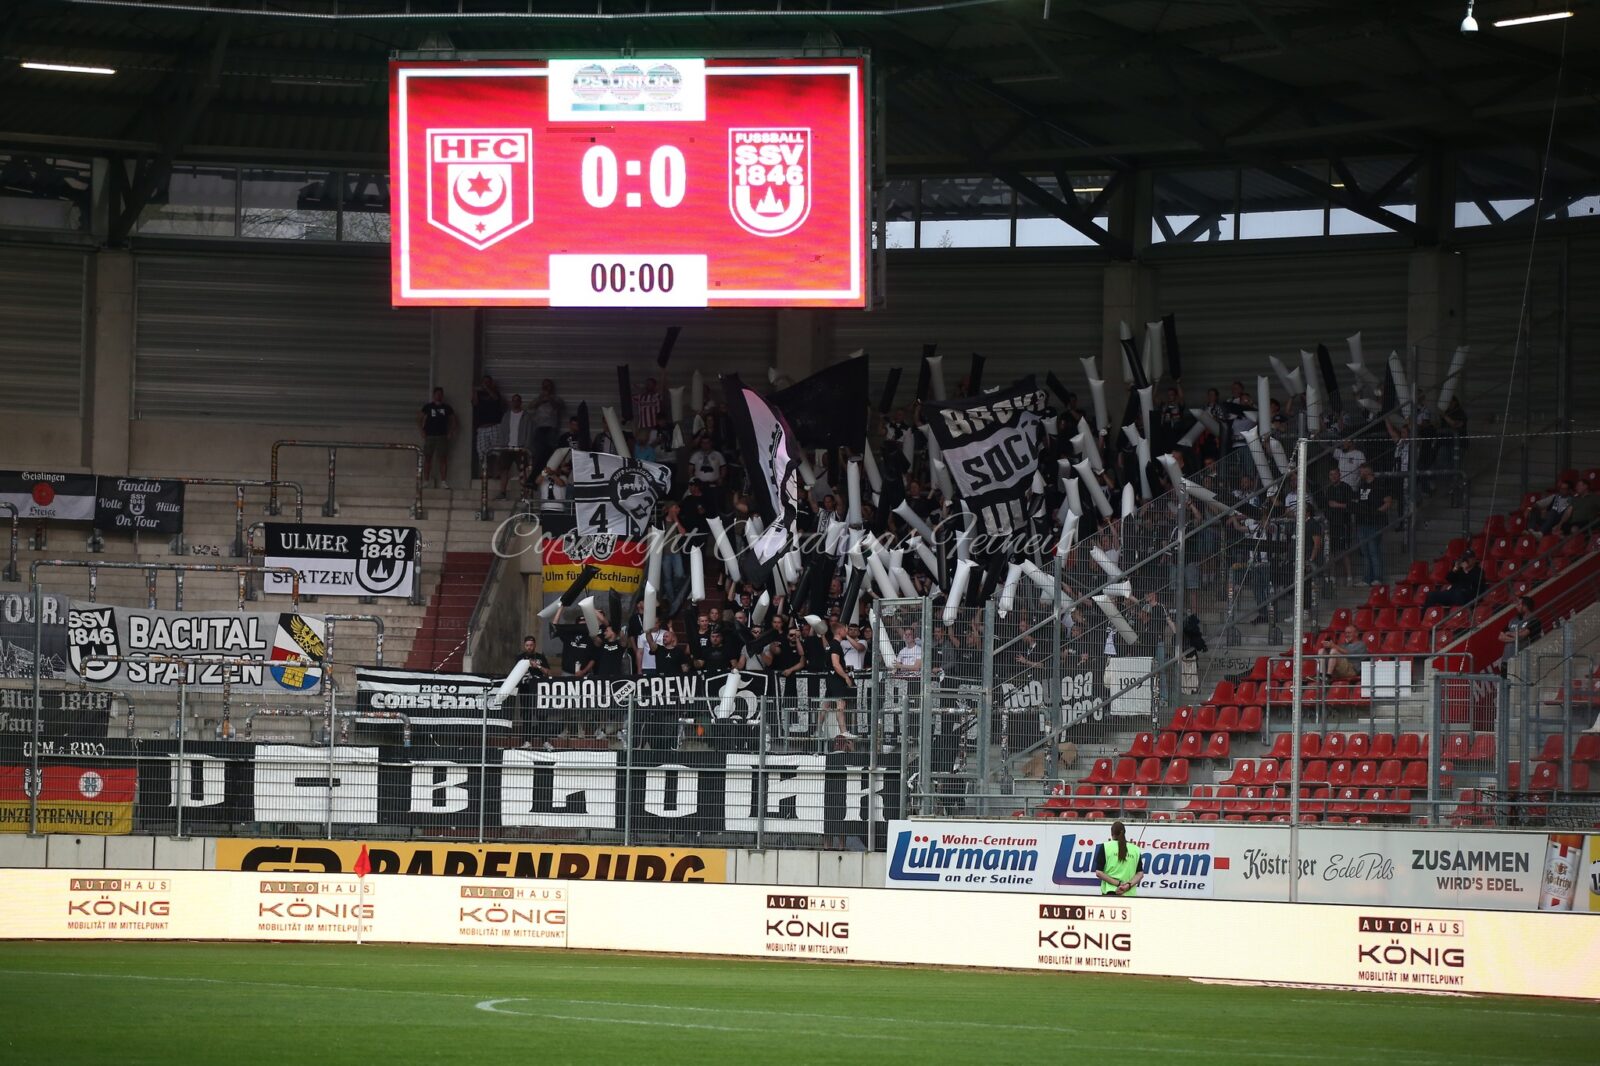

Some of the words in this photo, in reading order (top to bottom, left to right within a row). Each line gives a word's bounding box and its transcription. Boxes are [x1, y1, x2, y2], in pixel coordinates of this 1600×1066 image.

[735, 131, 804, 144] FUSSBALL
[440, 138, 520, 159] HFC
[734, 144, 804, 166] SSV
[581, 144, 686, 208] 0:0
[735, 165, 804, 186] 1846
[590, 263, 674, 293] 00:00
[117, 479, 161, 493] Fanclub
[99, 498, 122, 509] Volle
[156, 501, 181, 513] Hülle
[115, 514, 132, 527] On
[134, 515, 160, 528] Tour
[280, 532, 349, 553] ULMER
[362, 528, 409, 544] SSV
[360, 544, 406, 559] 1846
[545, 572, 564, 581] Ulm
[594, 572, 640, 585] utschland
[0, 594, 65, 625] OUR.
[68, 609, 112, 628] SSV
[68, 627, 115, 646] 1846
[130, 616, 266, 650] BACHTAL
[421, 684, 458, 694] nero
[536, 679, 611, 709] DONAU
[637, 675, 697, 707] CREW
[59, 691, 109, 711] 1846
[941, 834, 1038, 847] Wohn-Centrum
[888, 830, 1038, 882] Lührmann
[1412, 849, 1529, 873] ZUSAMMEN
[1323, 854, 1365, 881] Edel
[1358, 852, 1395, 881] Pils
[72, 879, 168, 891] AUTOHAUS
[965, 873, 987, 884] der
[990, 874, 1033, 885] Saline
[1159, 879, 1206, 890] Saline
[1436, 876, 1484, 892] WIRD'S
[1487, 877, 1524, 892] EDEL.
[263, 882, 371, 894] AUTOHAUS
[463, 886, 563, 899] AUTOHAUS
[68, 895, 170, 916] KÖNIG
[258, 898, 374, 919] KÖNIG
[769, 895, 847, 910] AUTOHAUS
[460, 903, 566, 925] KÖNIG
[1041, 905, 1129, 921] AUTOHAUS
[67, 920, 106, 930] MOBILITÄT
[108, 921, 117, 930] IM
[119, 922, 169, 931] MITTELPUNKT
[258, 923, 302, 932] MOBILITÄT
[304, 923, 314, 932] IM
[459, 927, 499, 937] MOBILITÄT
[501, 929, 511, 937] IM
[513, 929, 566, 939] MITTELPUNKT
[766, 915, 849, 939] KÖNIG
[1361, 918, 1461, 934] AUTOHAUS
[1038, 925, 1131, 951] KÖNIG
[765, 943, 797, 952] MOBILITÄT
[798, 944, 806, 953] IM
[807, 944, 849, 955] MITTELPUNKT
[1358, 939, 1465, 967] KÖNIG
[1038, 955, 1073, 966] MOBILITÄT
[1074, 956, 1083, 967] IM
[1085, 956, 1131, 969] MITTELPUNKT
[1358, 971, 1398, 982] MOBILITÄT
[1400, 972, 1409, 983] IM
[1411, 973, 1464, 985] MITTELPUNKT
